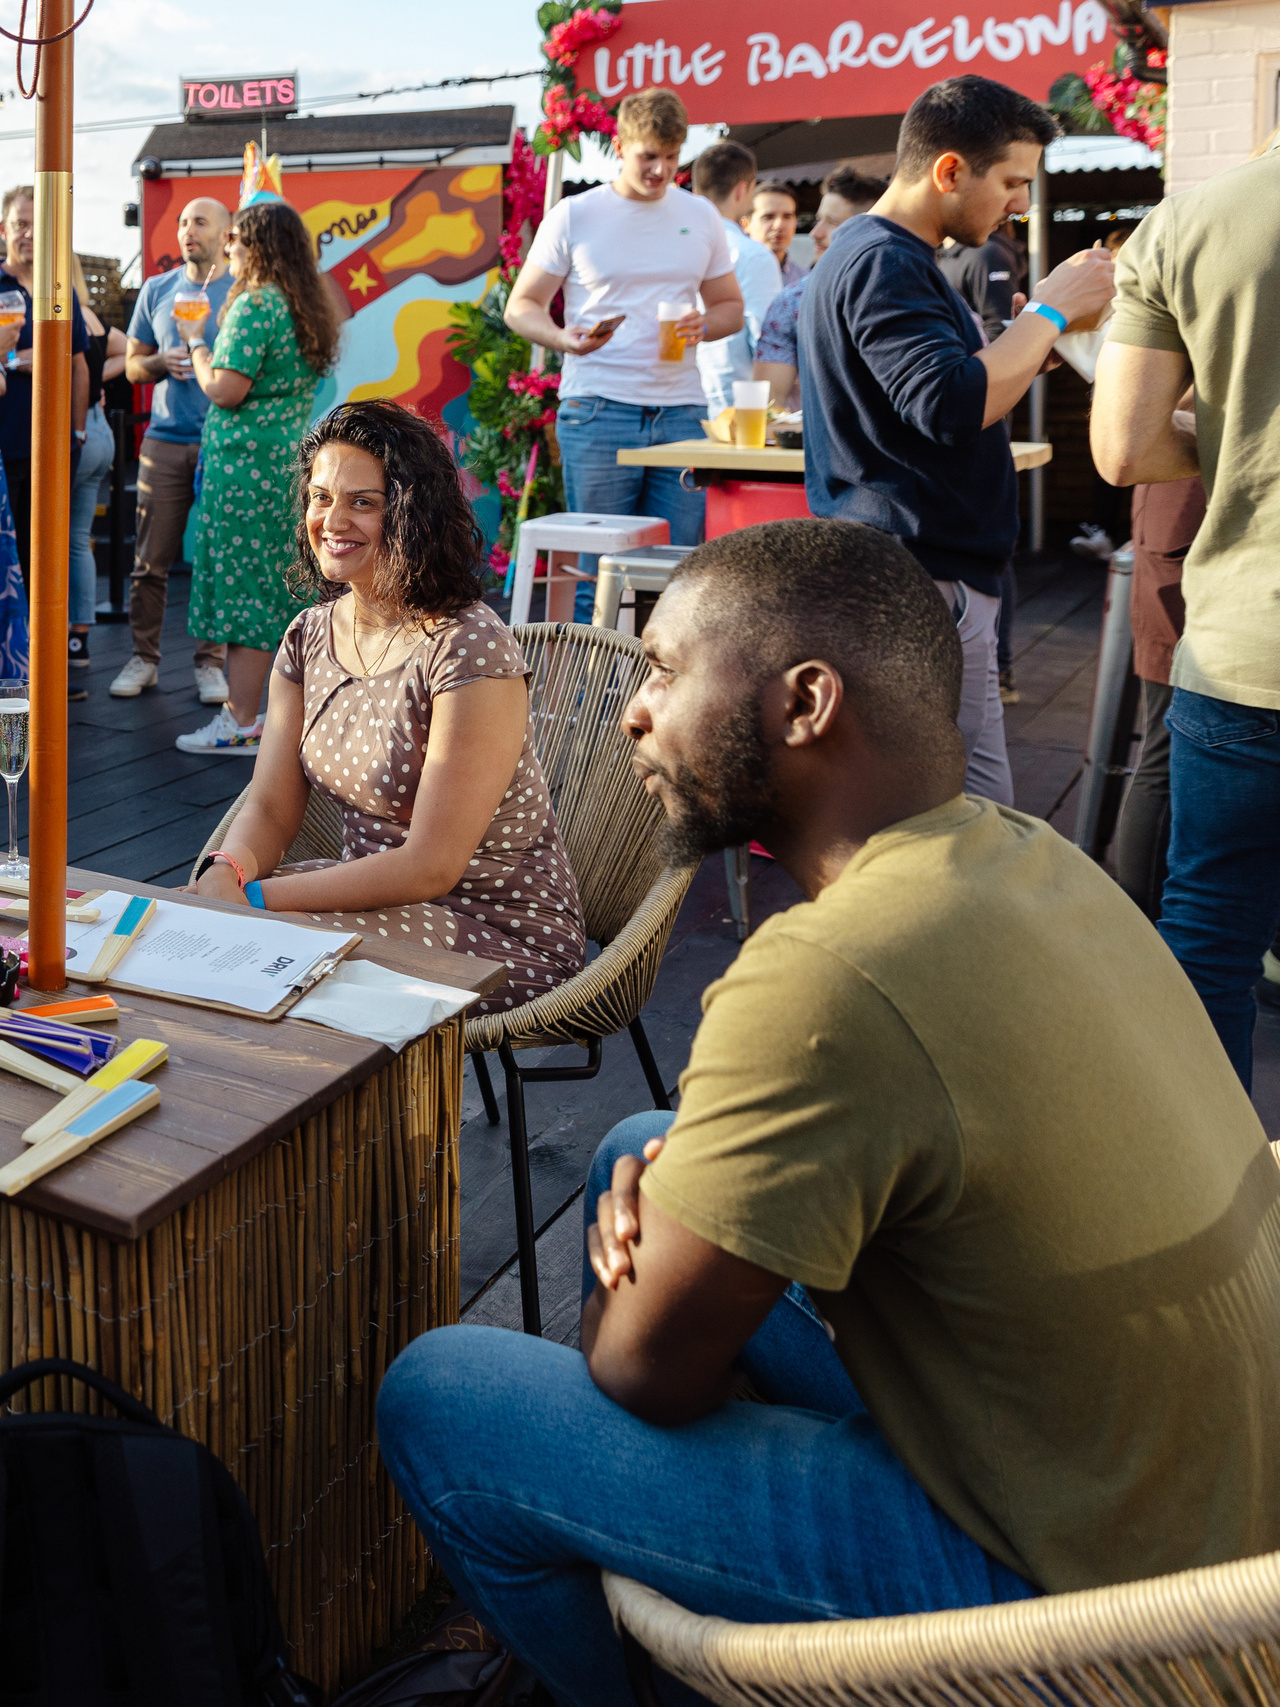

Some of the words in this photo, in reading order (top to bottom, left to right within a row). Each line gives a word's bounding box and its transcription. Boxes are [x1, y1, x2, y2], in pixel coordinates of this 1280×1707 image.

[594, 37, 726, 97] LITTLE
[747, 0, 1108, 86] BARCELONA
[183, 79, 296, 109] TOILETS
